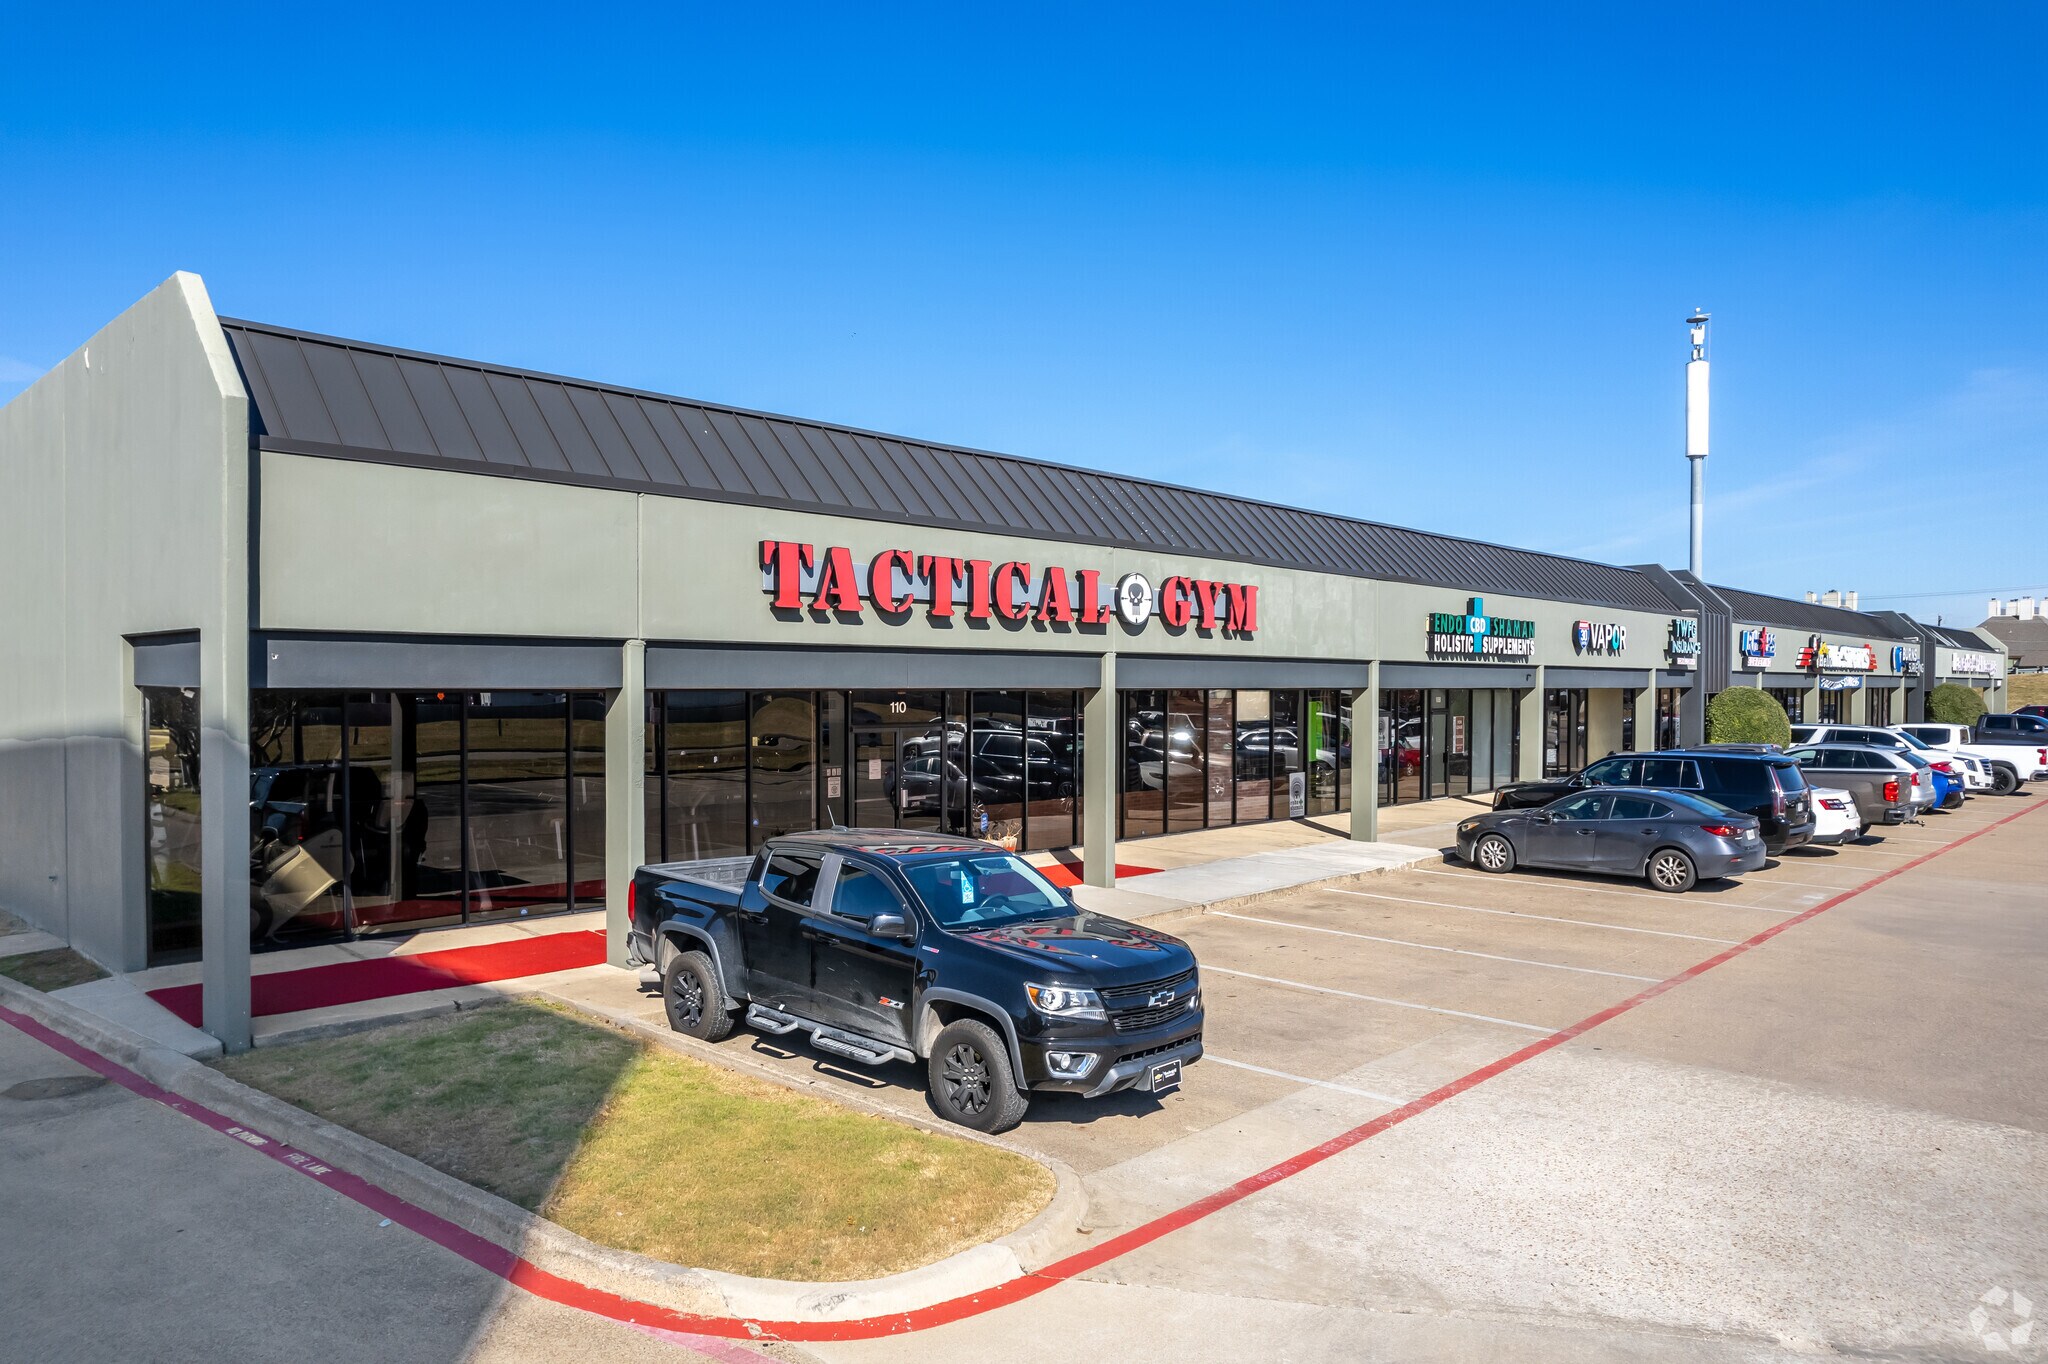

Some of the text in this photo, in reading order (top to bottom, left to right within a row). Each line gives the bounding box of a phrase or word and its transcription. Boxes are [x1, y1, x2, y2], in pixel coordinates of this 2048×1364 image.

[761, 540, 1259, 632] TACTICAL GYM
[1434, 613, 1535, 639] ENDO CBD SHAMAN
[1580, 623, 1627, 650] 30 VAPOR
[1675, 619, 1697, 638] TWFG
[1434, 634, 1535, 656] HOLISTIC SUPPLEMENTS
[1672, 641, 1701, 654] INSURANCE
[890, 701, 906, 713] 110
